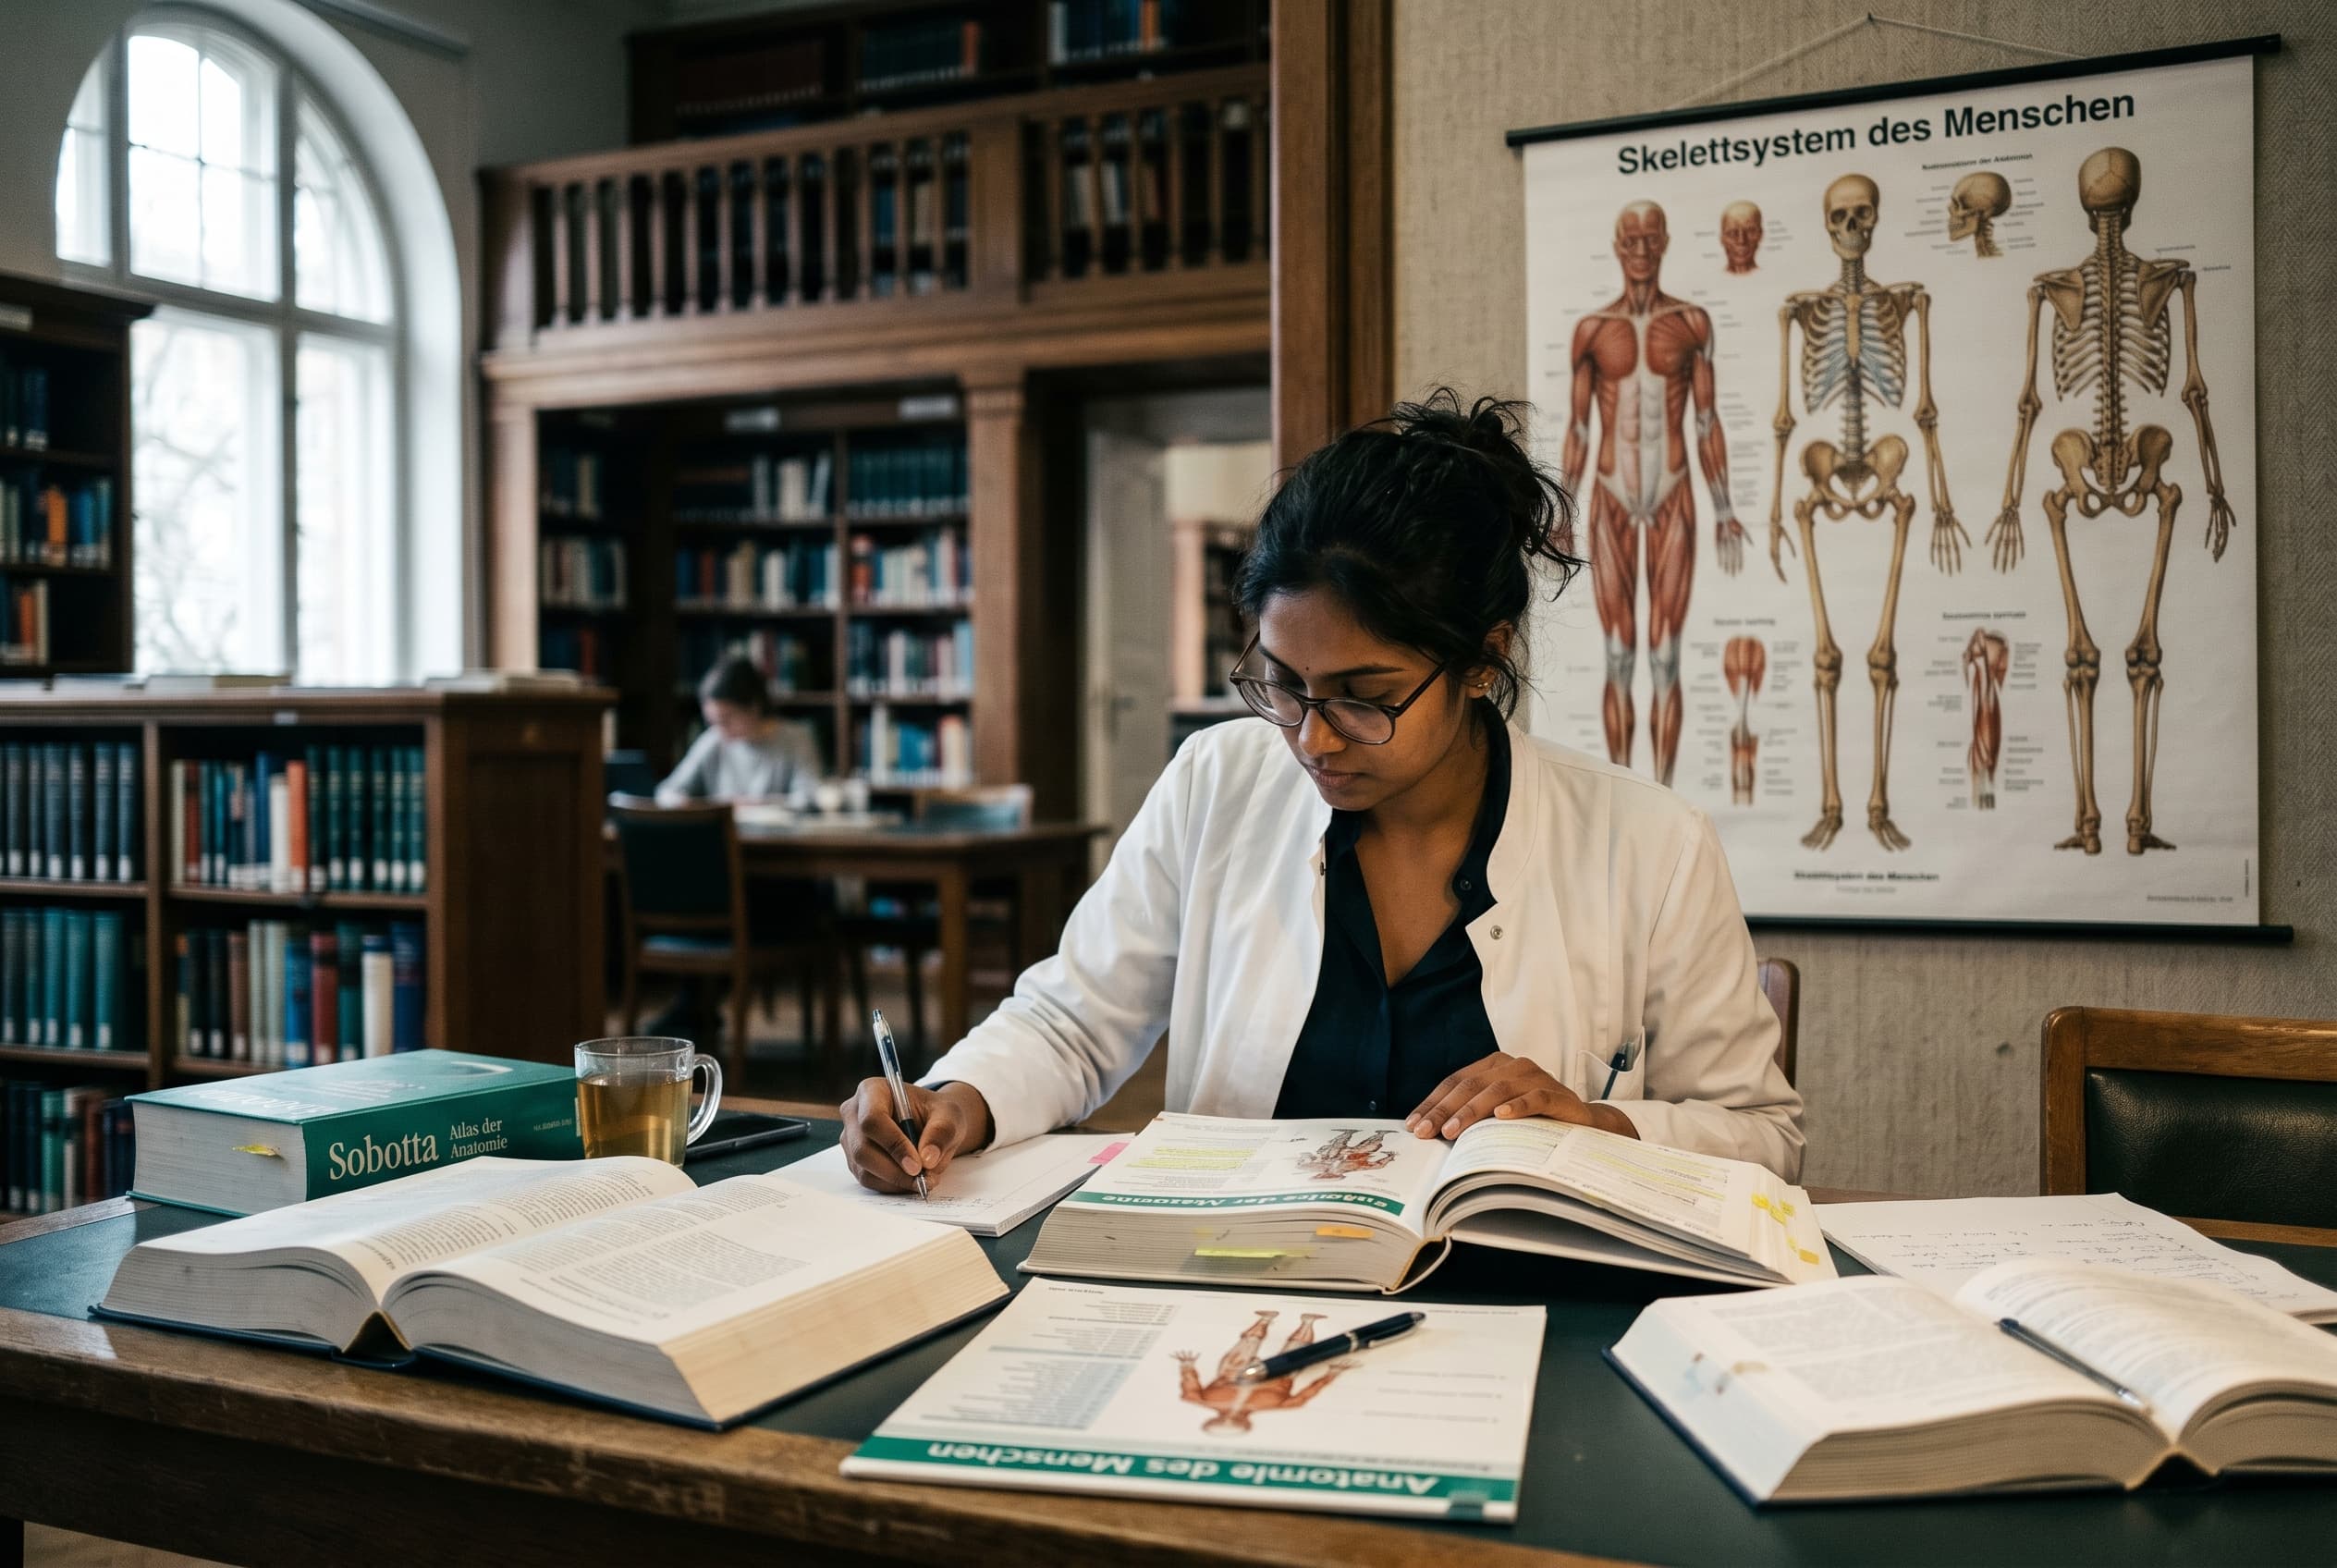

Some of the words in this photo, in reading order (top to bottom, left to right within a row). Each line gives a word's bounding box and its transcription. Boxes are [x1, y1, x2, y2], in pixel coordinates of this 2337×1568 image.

[1618, 127, 1856, 175] Skelettsystem
[1868, 116, 1931, 146] des
[1944, 94, 2135, 138] Menschen
[449, 1121, 479, 1140] Atlas
[482, 1117, 503, 1133] der
[328, 1133, 440, 1182] Sobotta
[450, 1134, 508, 1158] Anatomie
[927, 1442, 1135, 1474] Menschen
[1144, 1457, 1219, 1479] des
[1230, 1463, 1439, 1495] Anatomie
